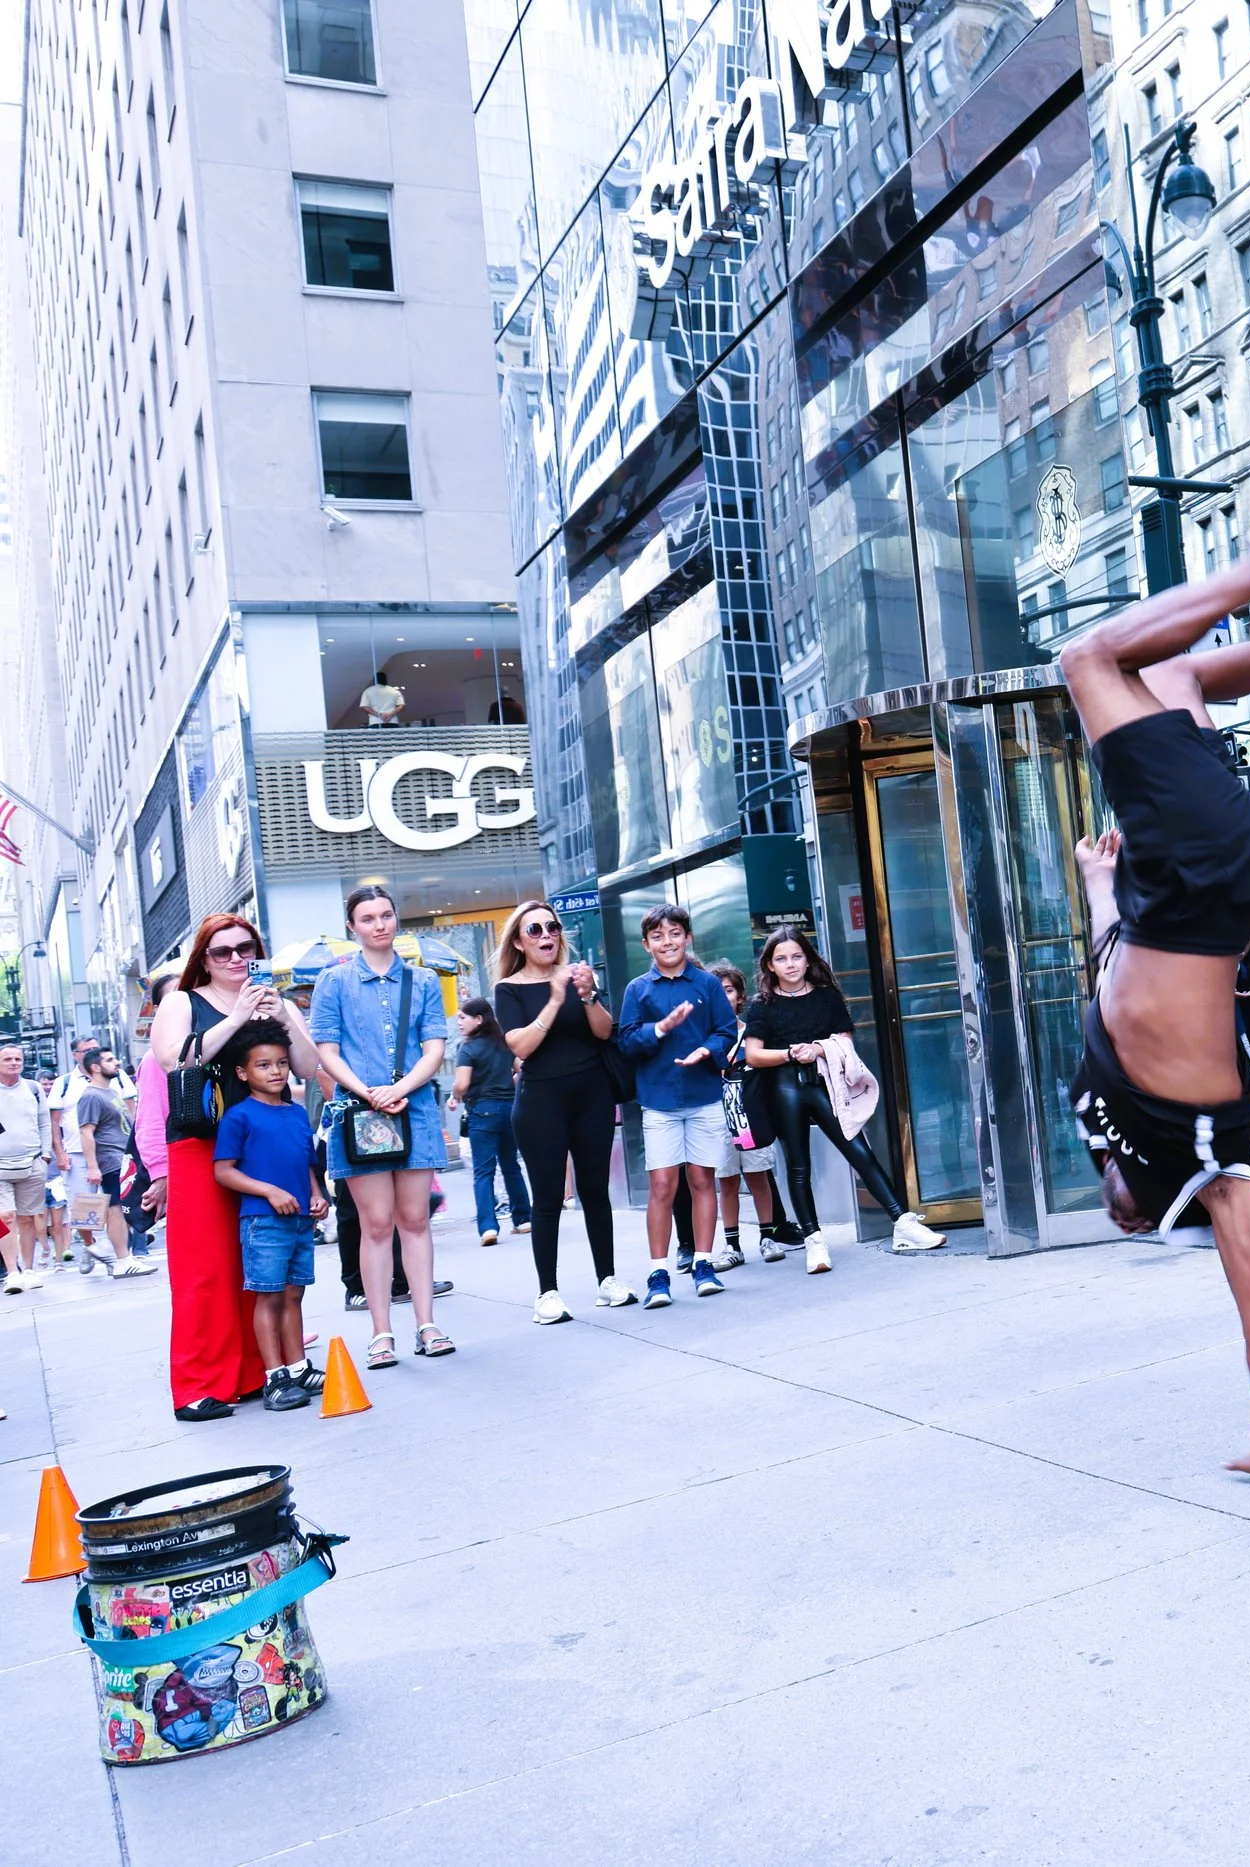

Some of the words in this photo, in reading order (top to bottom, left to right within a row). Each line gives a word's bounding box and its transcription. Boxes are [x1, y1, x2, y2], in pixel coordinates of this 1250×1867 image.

[642, 77, 769, 289] Safra
[769, 0, 895, 132] Na
[301, 751, 537, 850] UGG
[125, 1536, 179, 1554] Lexington
[172, 1569, 247, 1599] essentia
[104, 1667, 132, 1688] prite
